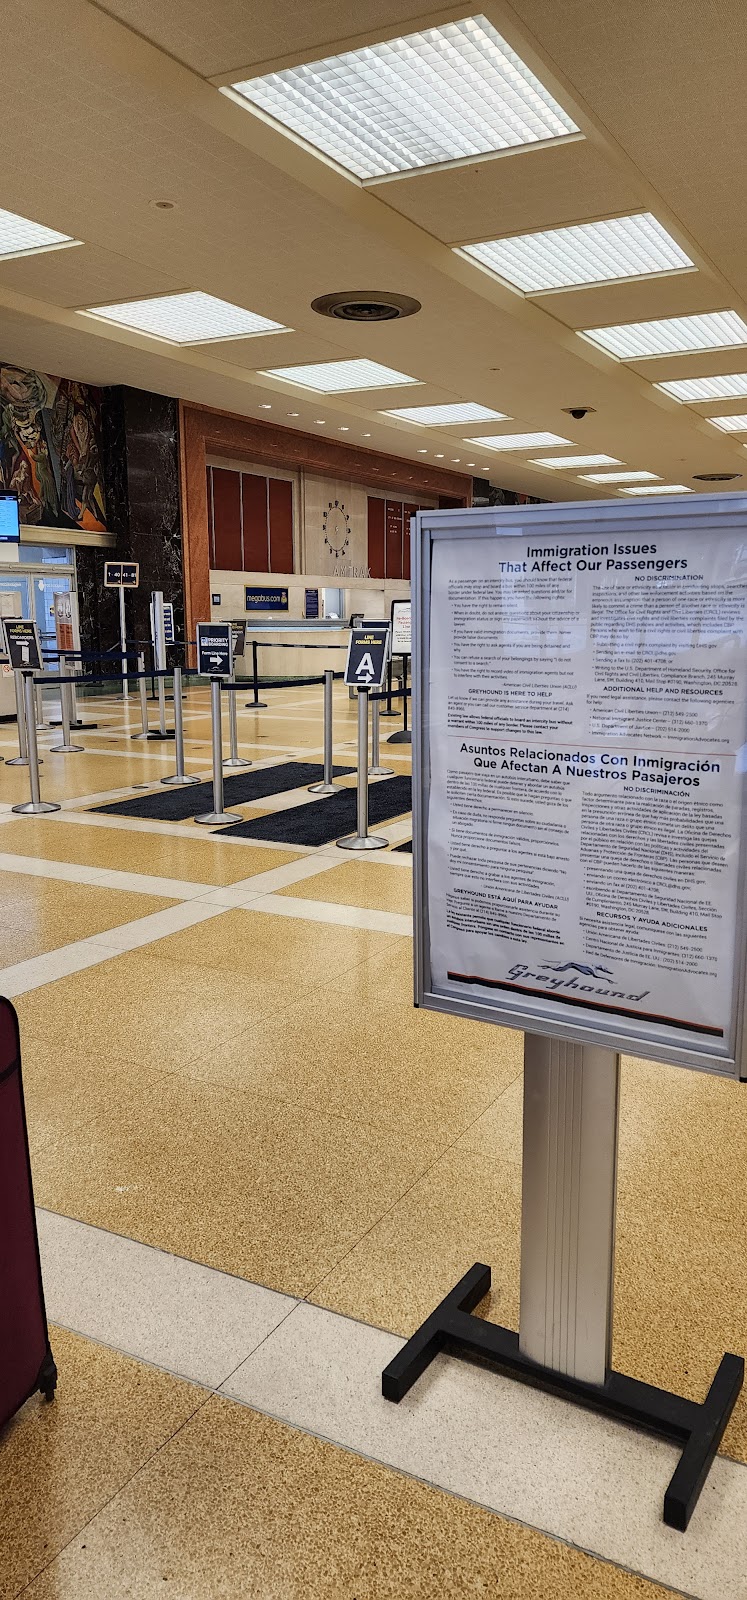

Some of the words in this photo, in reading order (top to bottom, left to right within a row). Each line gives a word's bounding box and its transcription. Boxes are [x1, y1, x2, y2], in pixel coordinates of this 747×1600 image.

[527, 544, 609, 559] Immigration
[613, 543, 657, 555] Issues
[499, 562, 527, 573] That
[531, 560, 572, 572] Affect
[576, 560, 602, 571] Our
[606, 558, 688, 573] Passengers
[247, 595, 280, 603] megabus.com
[355, 653, 375, 674] A
[460, 745, 506, 757] Asuntos
[510, 747, 596, 764] Relacionados
[600, 754, 628, 766] Con
[632, 755, 720, 775] Inmigración
[474, 758, 497, 771] Que
[501, 760, 548, 774] Afectan
[552, 764, 562, 775] A
[566, 765, 627, 780] Nuestros
[631, 769, 700, 789] Pasajeros
[635, 786, 690, 797] DISCRIMINACIÓN
[453, 888, 487, 898] GREYHOUND
[502, 895, 517, 903] AQUÍ
[534, 901, 558, 910] AYUDAR
[597, 911, 631, 921] RECURSOS
[661, 920, 708, 932] ADICIONALES
[506, 964, 650, 1002] Greyhound
